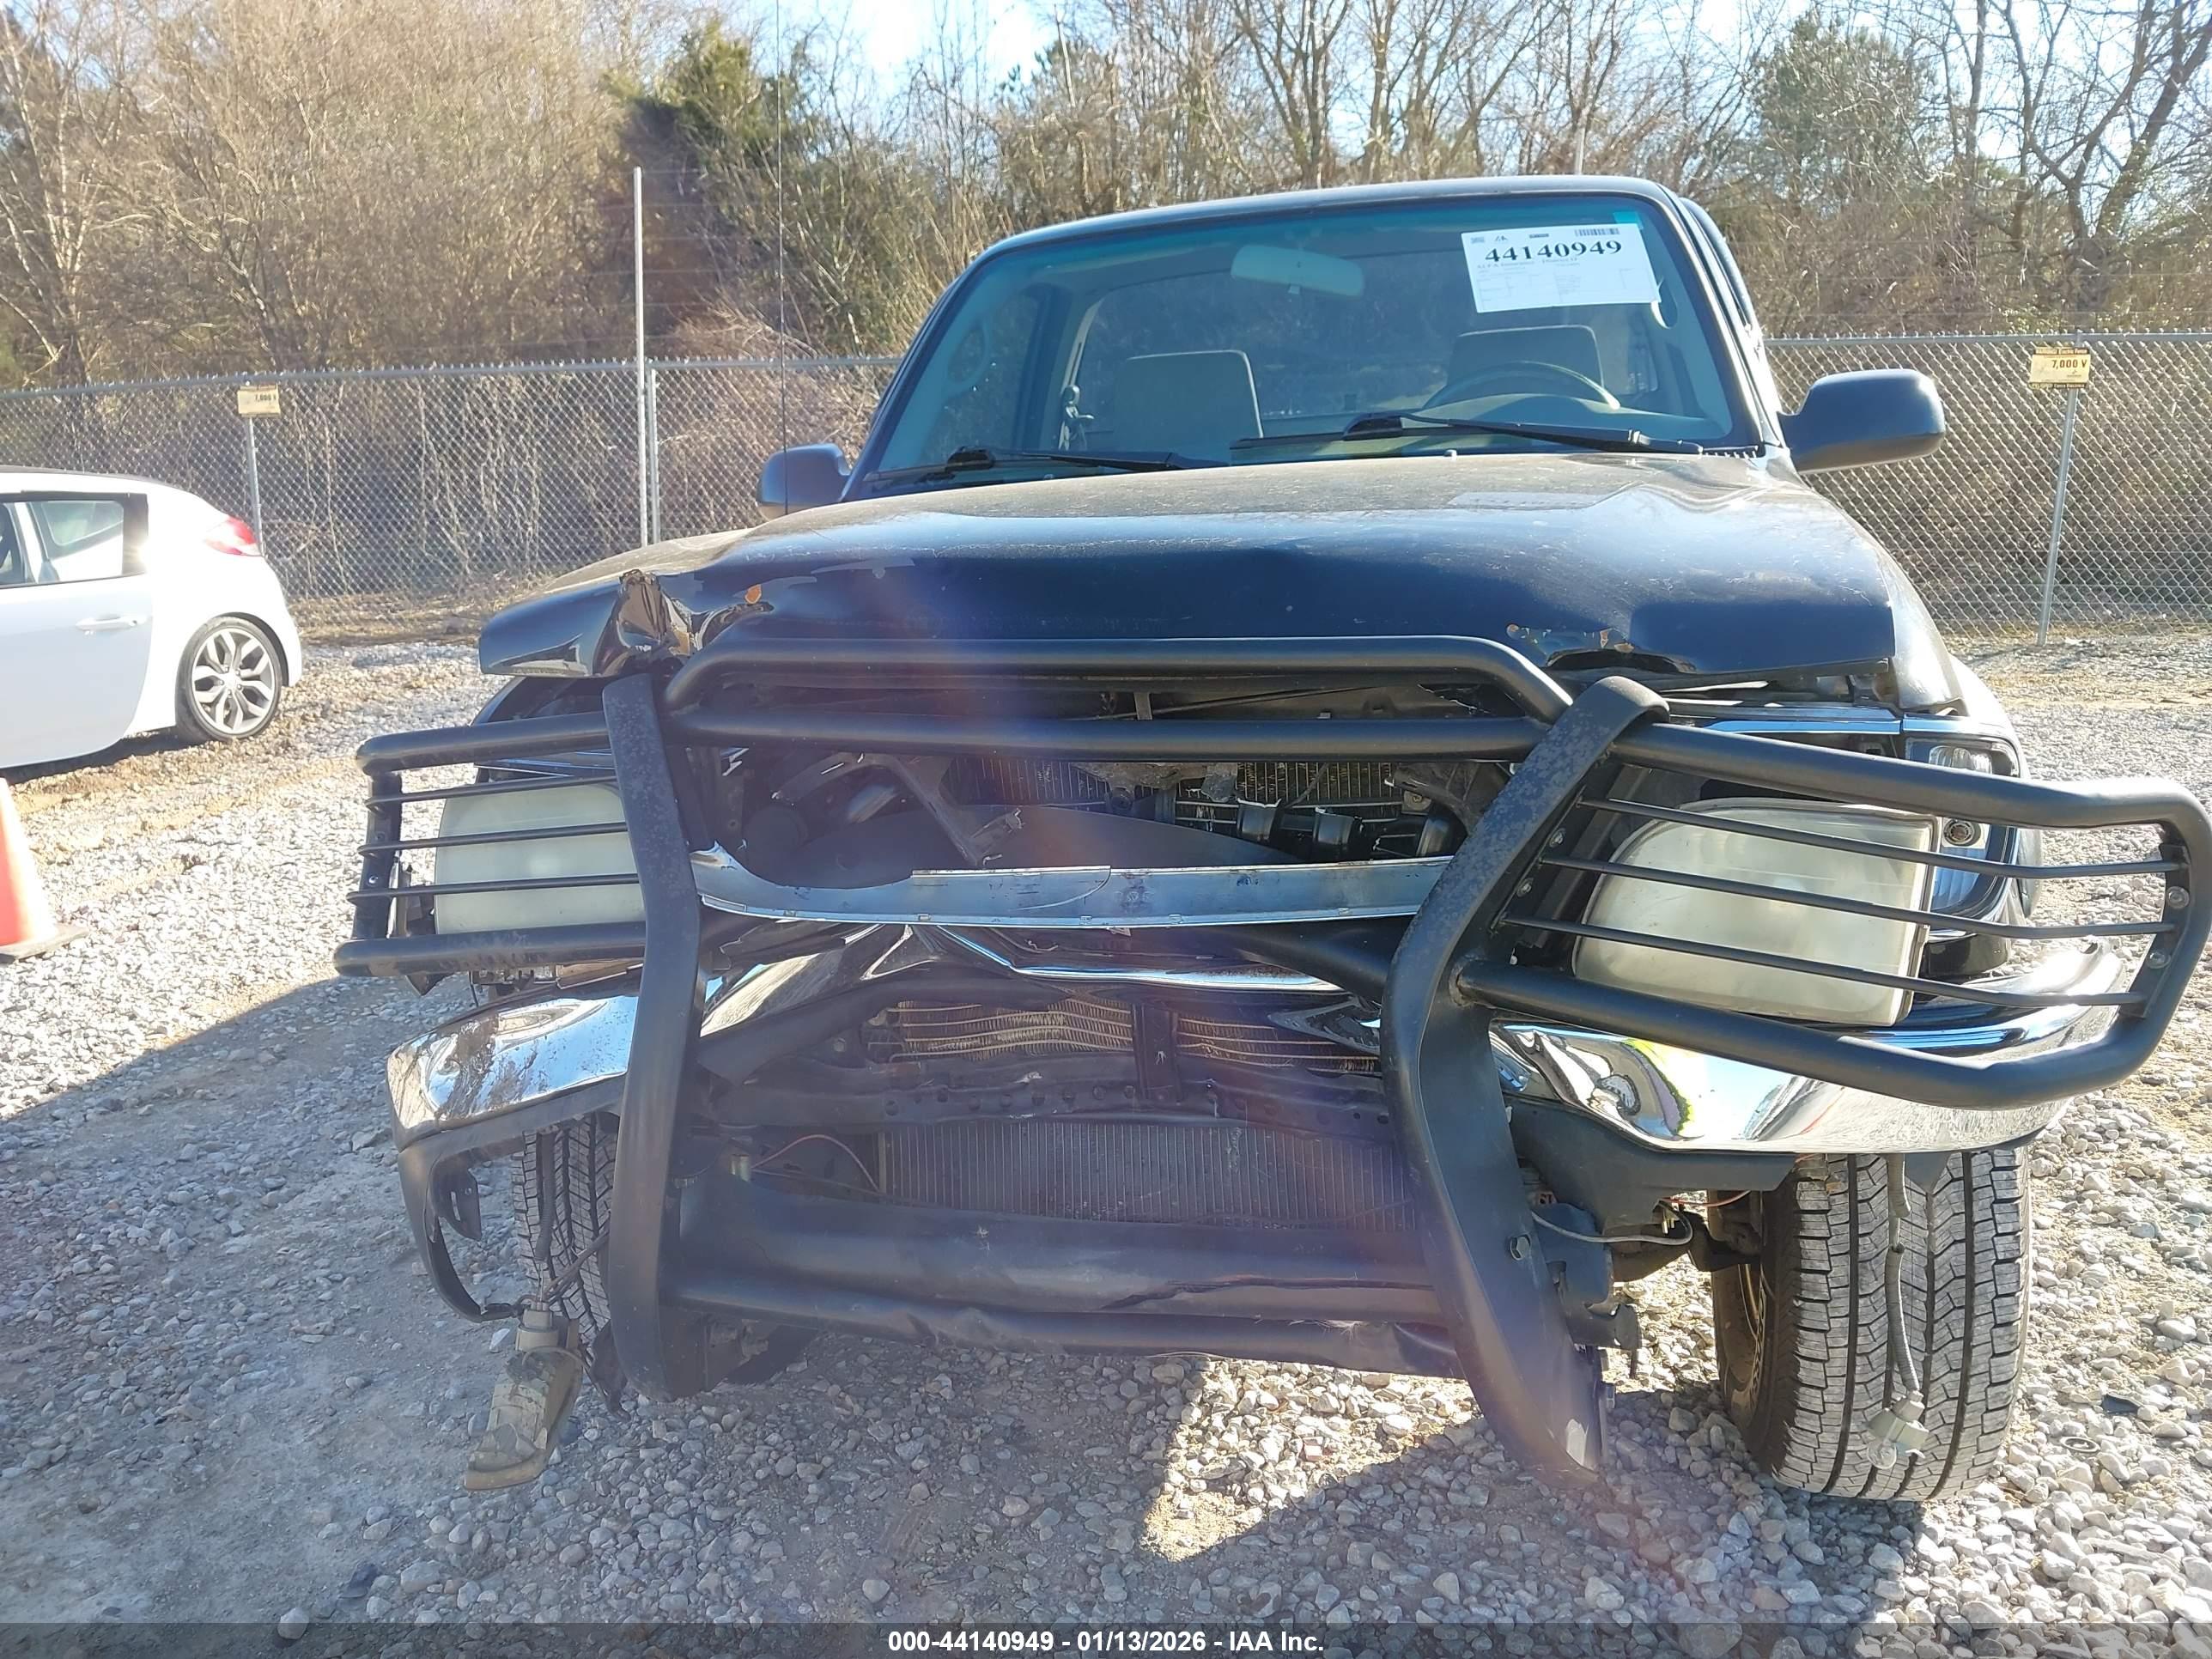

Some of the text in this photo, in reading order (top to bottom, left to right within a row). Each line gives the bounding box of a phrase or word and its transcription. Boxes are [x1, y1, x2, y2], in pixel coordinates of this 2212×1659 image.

[1485, 240, 1622, 262] 44140949
[2052, 359, 2087, 369] 7,000 V
